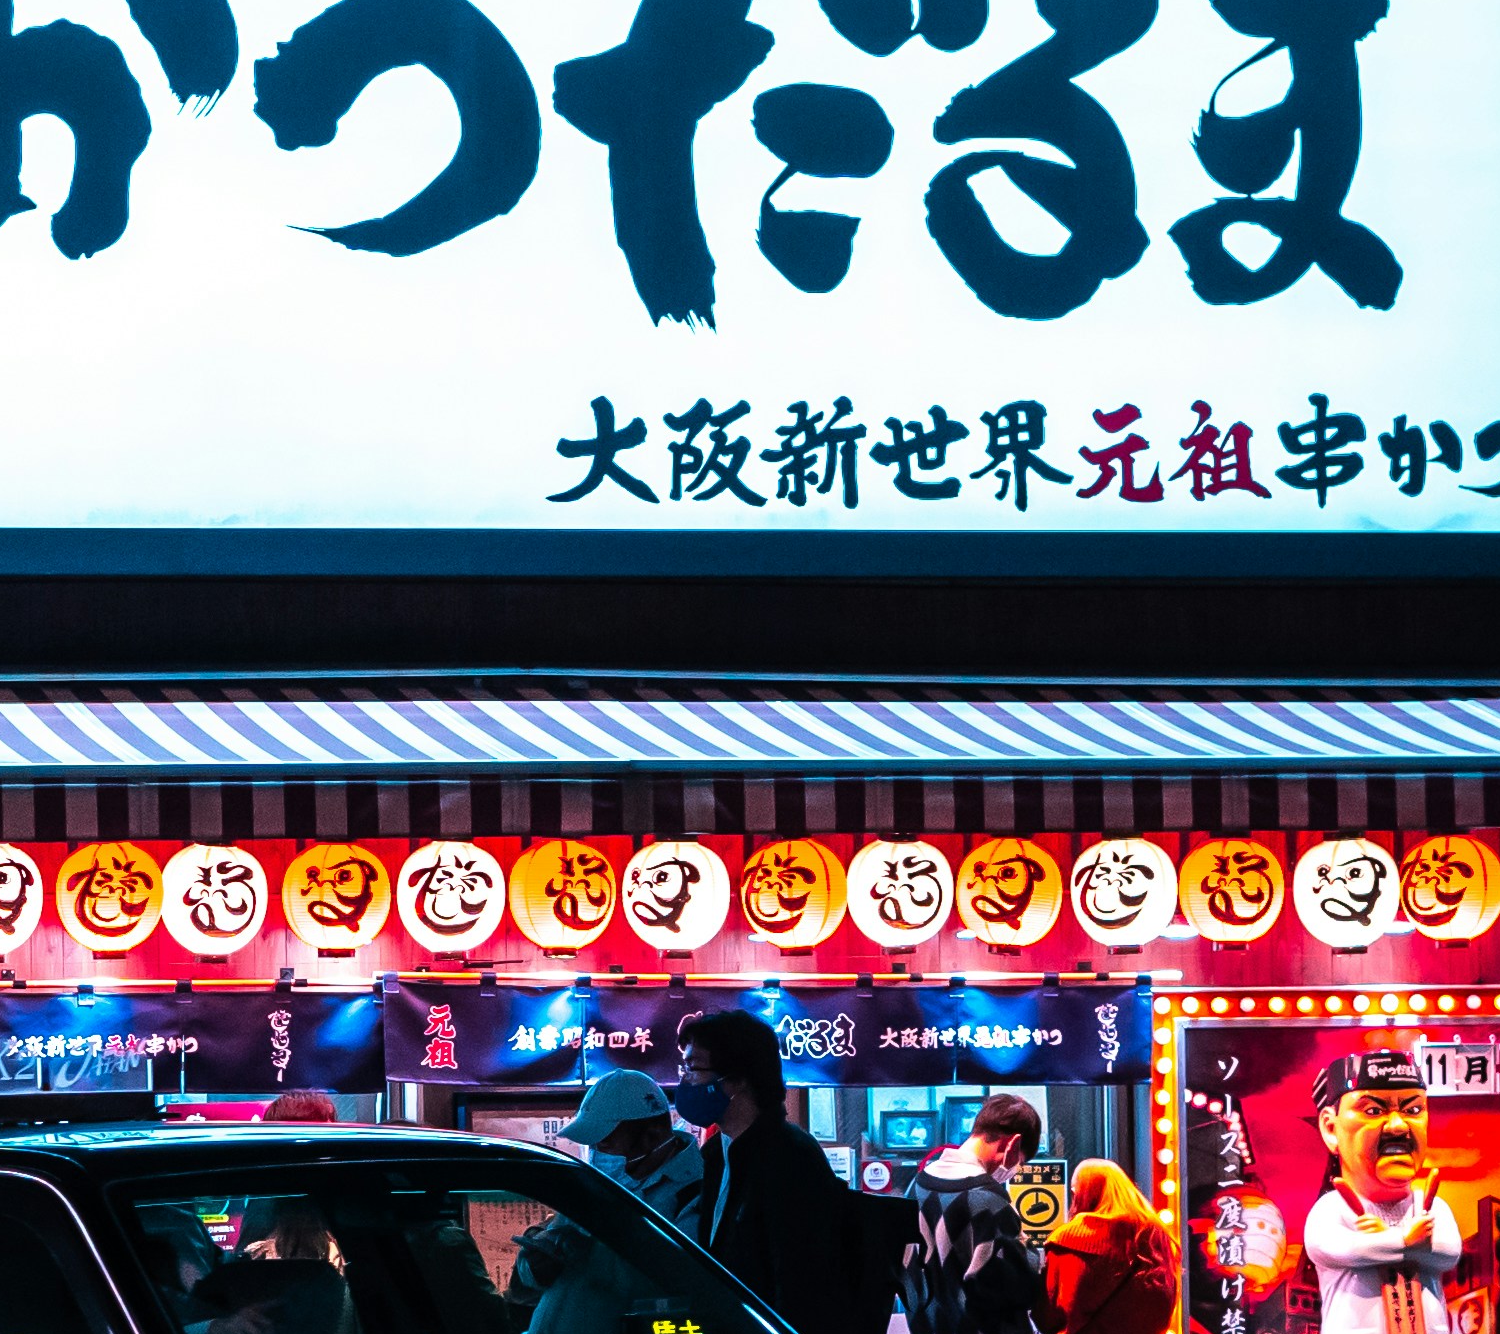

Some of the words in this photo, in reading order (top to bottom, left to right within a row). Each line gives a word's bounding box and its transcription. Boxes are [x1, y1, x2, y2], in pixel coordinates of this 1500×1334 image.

[421, 1003, 459, 1070] 元祖
[508, 1025, 655, 1053] 創業昭和四年
